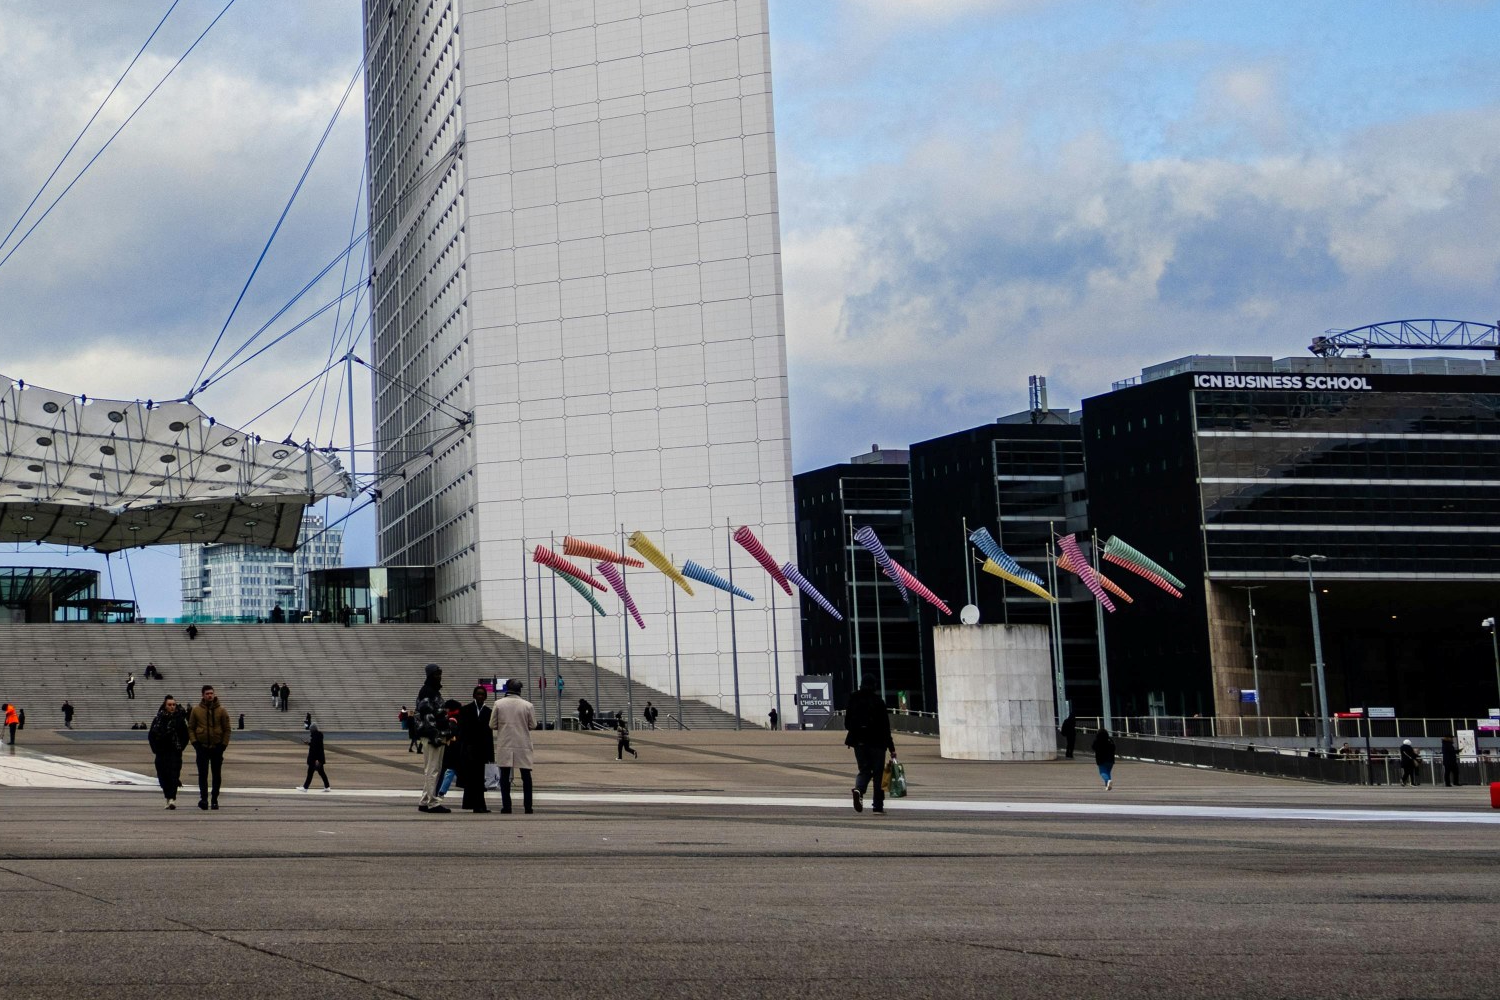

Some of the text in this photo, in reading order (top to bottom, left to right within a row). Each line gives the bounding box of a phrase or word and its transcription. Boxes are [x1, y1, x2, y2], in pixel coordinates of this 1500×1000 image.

[1194, 374, 1372, 390] ICN BUSINESS SCHOOL
